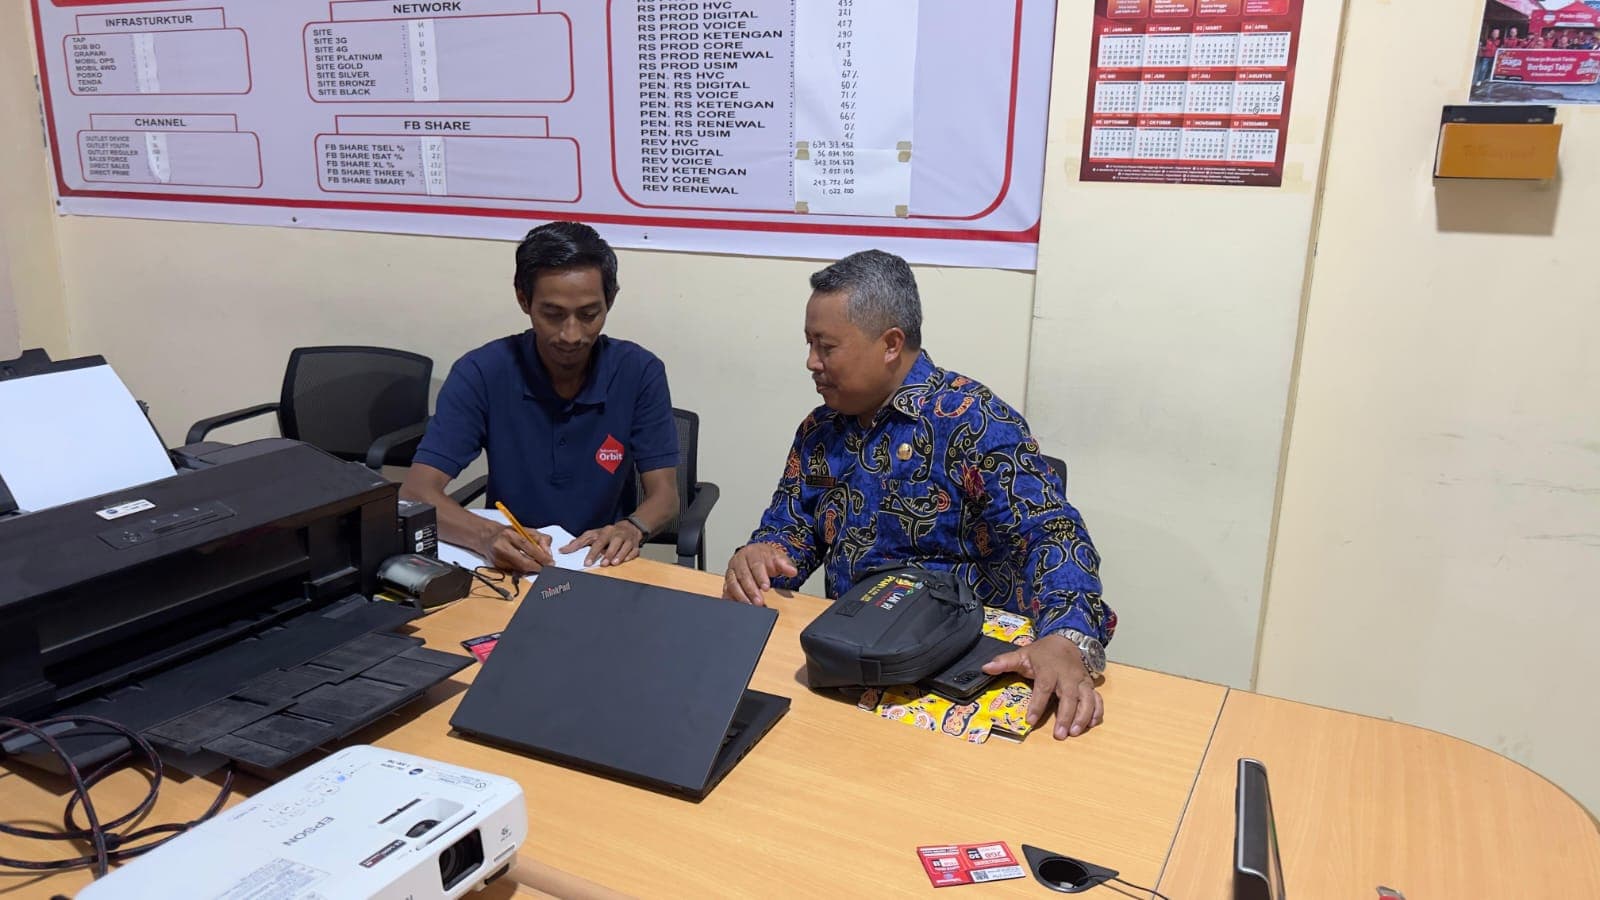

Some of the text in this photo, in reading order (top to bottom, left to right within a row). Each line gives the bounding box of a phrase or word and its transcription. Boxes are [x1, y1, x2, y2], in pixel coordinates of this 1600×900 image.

[393, 2, 461, 13] NETWORK
[660, 3, 698, 11] PROD
[703, 11, 758, 20] DIGITAL
[105, 16, 193, 27] INFRASTURKTUR
[703, 21, 746, 30] VOICE
[704, 30, 782, 39] KETENGAN
[404, 121, 471, 130] FB SHARE
[672, 168, 747, 176] KETENGAN
[673, 186, 739, 194] RENEWAL
[600, 452, 623, 461] Orbit
[540, 581, 570, 600] ThinkPad
[282, 816, 335, 846] EPSON
